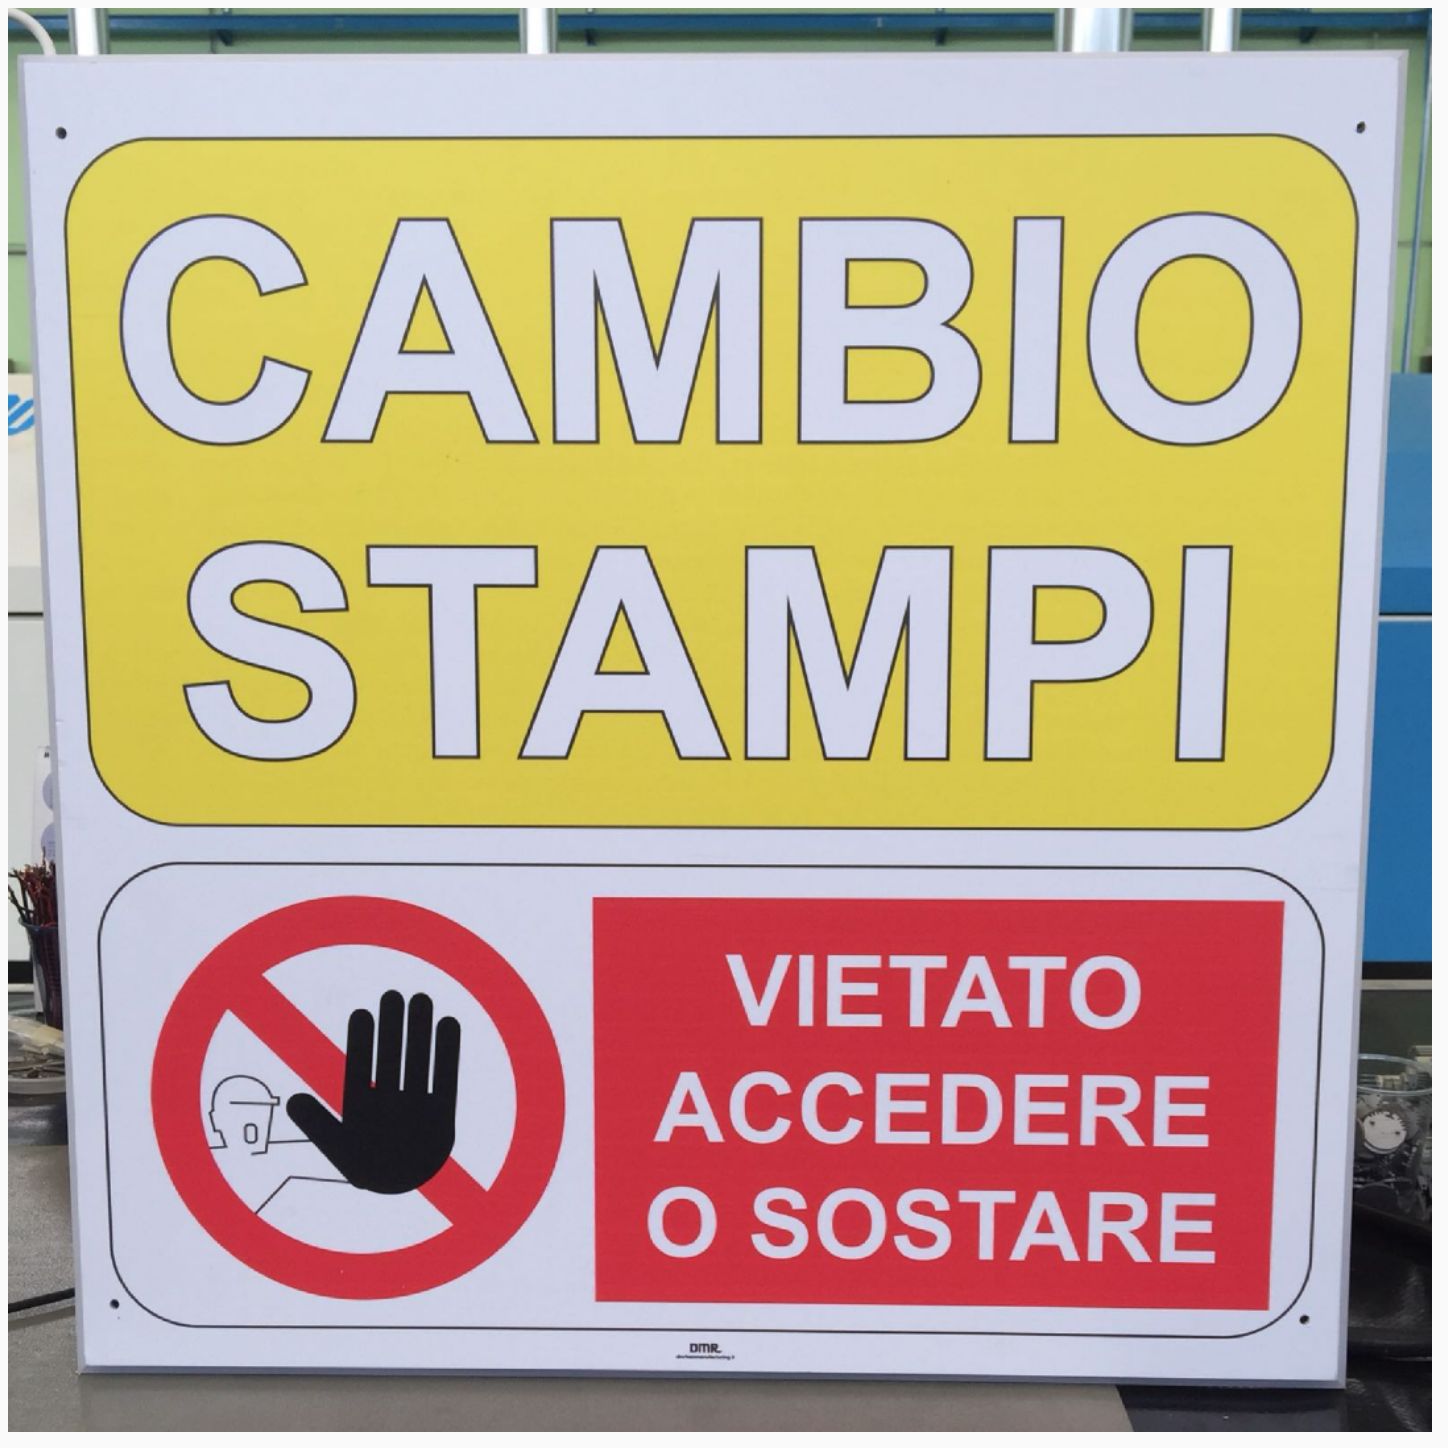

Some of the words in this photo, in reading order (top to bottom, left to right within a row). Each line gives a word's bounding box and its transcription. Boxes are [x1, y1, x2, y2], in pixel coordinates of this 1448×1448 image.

[119, 211, 1303, 446] CAMBIO
[183, 540, 1234, 762] STAMPI
[726, 954, 1141, 1030] VIETATO
[653, 1071, 1210, 1148] ACCEDERE
[647, 1186, 718, 1259] O
[751, 1187, 1217, 1264] SOSTARE
